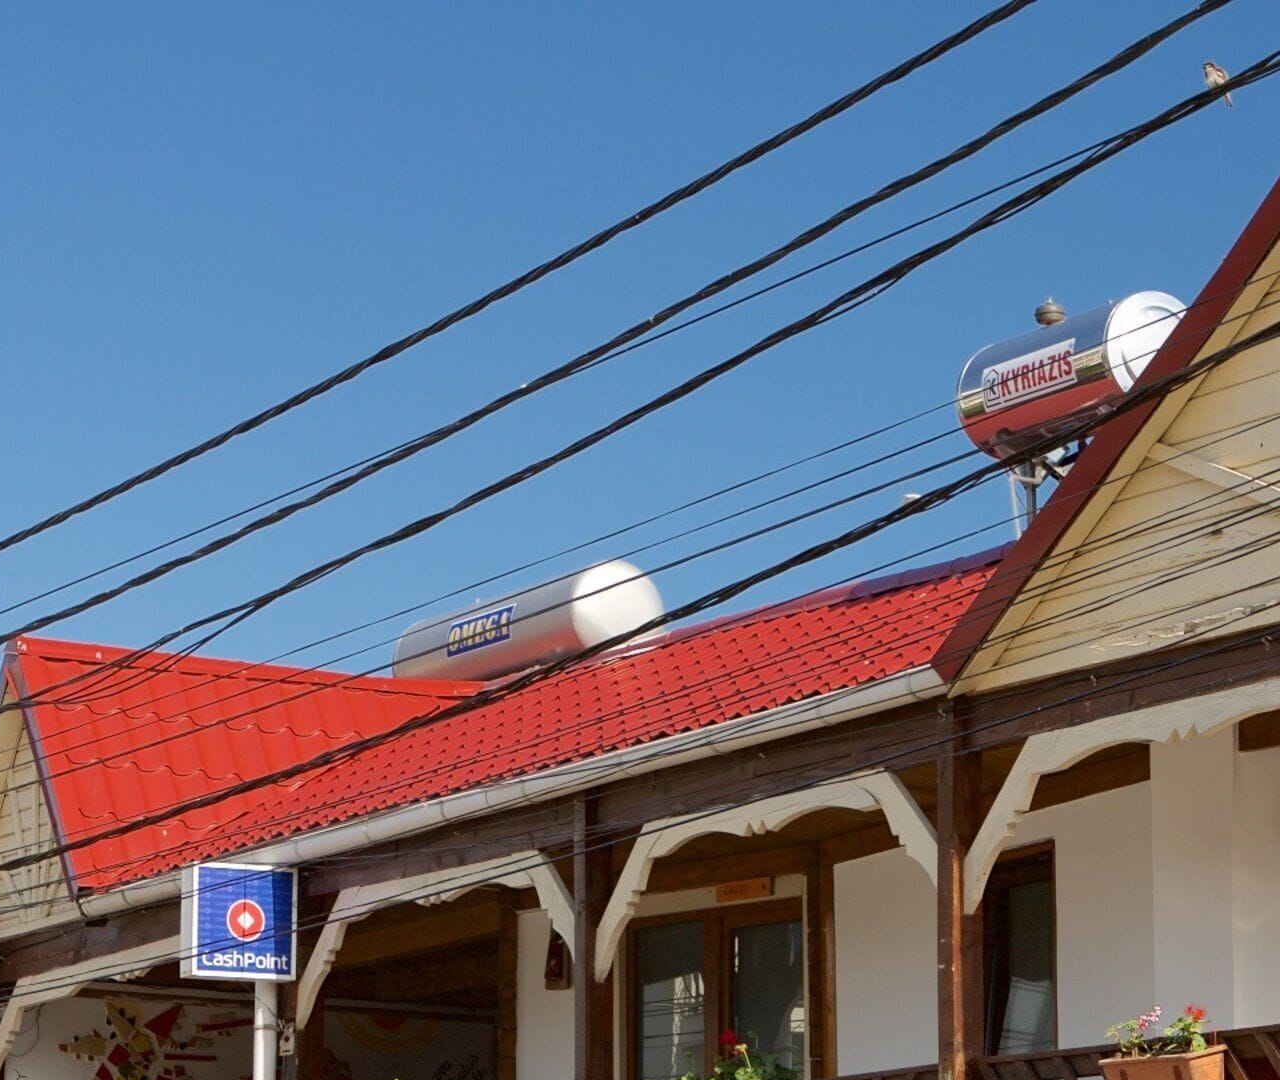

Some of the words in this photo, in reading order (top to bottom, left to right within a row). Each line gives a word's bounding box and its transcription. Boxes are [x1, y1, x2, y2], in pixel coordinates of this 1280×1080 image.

[1001, 350, 1072, 396] KYRIAZIS
[449, 611, 508, 652] OMEGA
[202, 950, 288, 970] CashPoint
